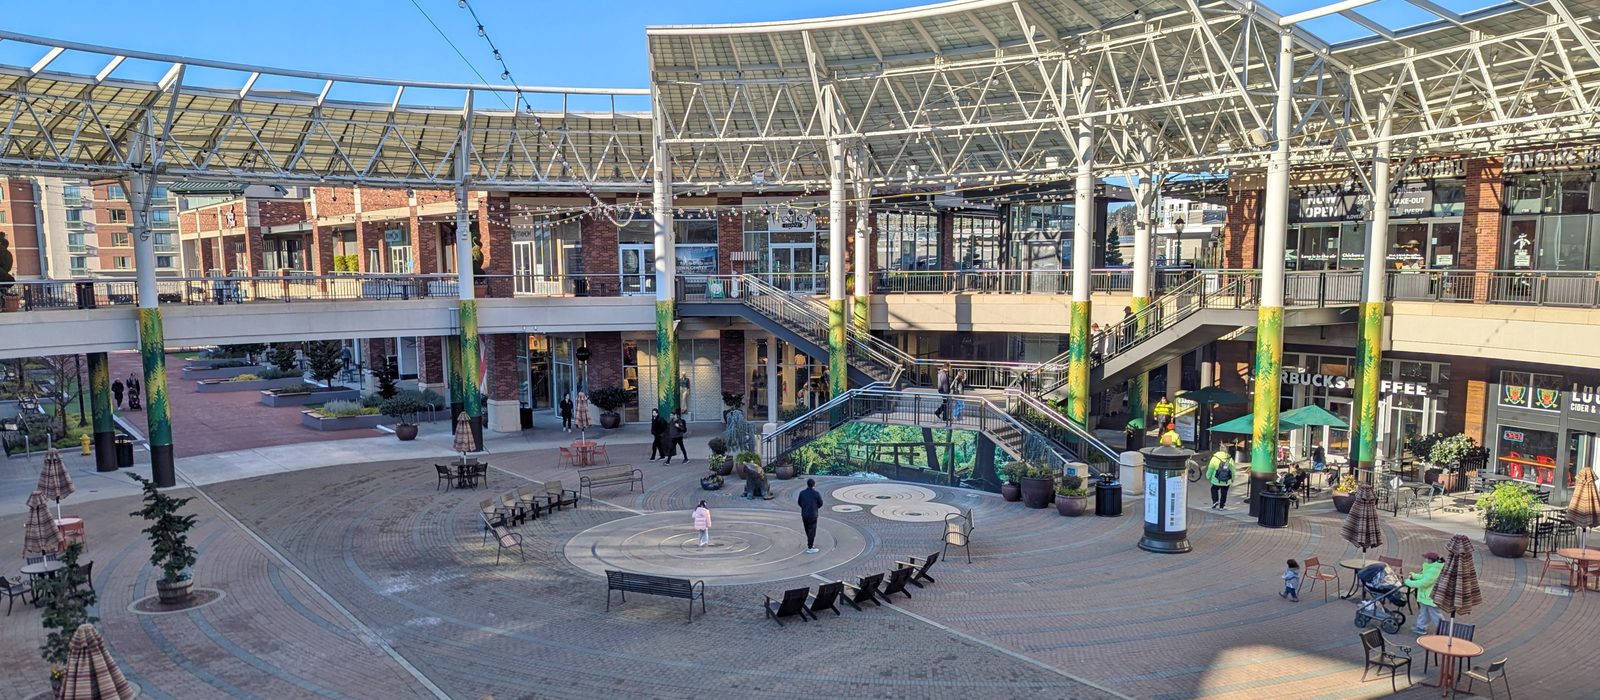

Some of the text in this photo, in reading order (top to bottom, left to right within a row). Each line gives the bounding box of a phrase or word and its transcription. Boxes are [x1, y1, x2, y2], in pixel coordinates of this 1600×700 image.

[1503, 151, 1578, 169] PANCAKE
[1305, 205, 1338, 218] OPEN
[1381, 380, 1427, 396] FFEE
[1570, 402, 1597, 413] CIDER &
